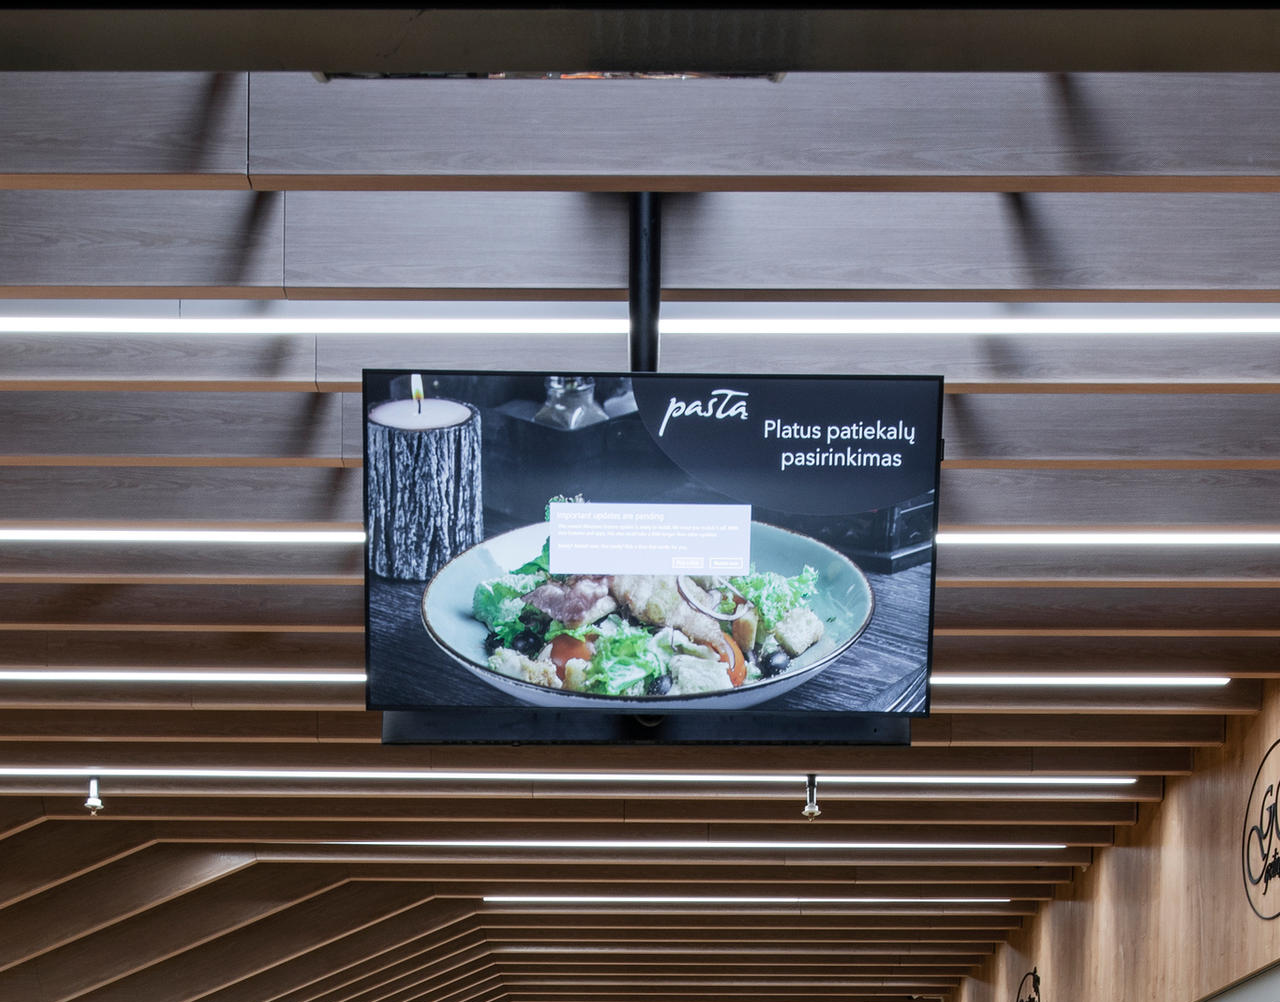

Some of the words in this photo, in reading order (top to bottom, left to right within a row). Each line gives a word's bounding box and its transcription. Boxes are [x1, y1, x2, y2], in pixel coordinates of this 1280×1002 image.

[764, 419, 821, 441] Platus
[826, 420, 916, 445] patiekalų
[781, 447, 902, 471] pasirinkimas
